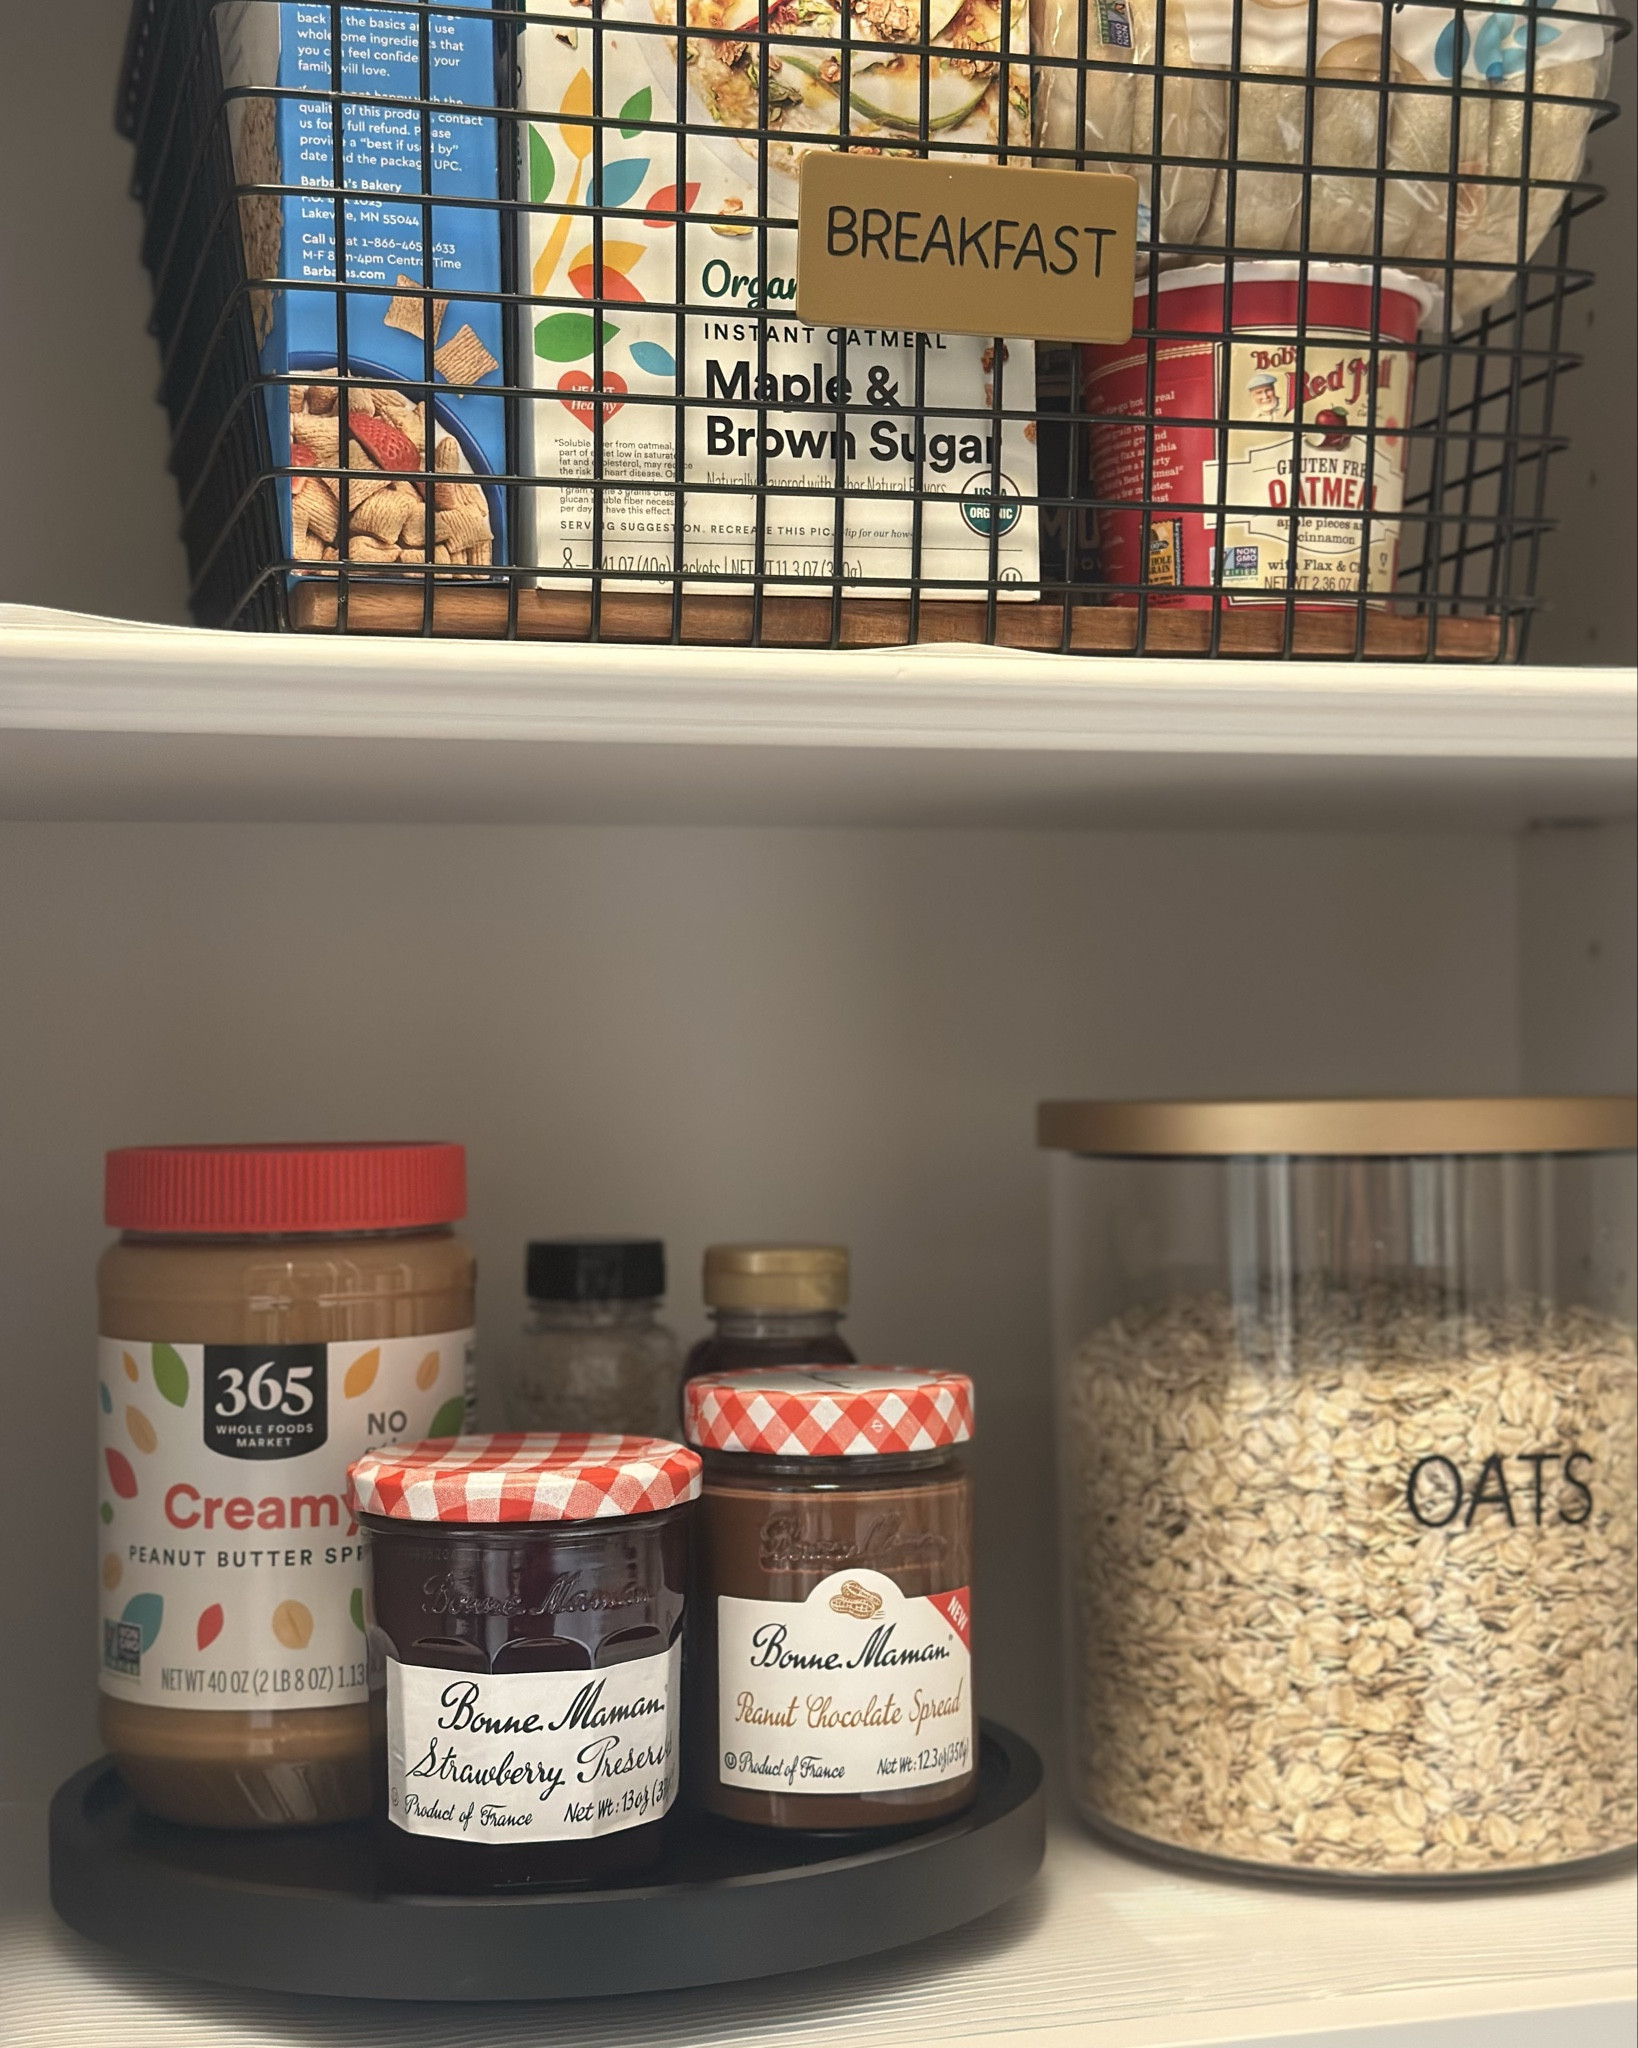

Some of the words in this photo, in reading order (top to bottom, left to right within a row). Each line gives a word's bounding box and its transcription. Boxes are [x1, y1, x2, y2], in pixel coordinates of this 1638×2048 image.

[297, 12, 326, 24] back
[346, 16, 366, 27] the
[369, 17, 406, 30] basics
[435, 26, 455, 34] use
[297, 30, 367, 43] wholeome
[440, 40, 464, 52] that
[297, 46, 319, 57] you
[349, 48, 370, 60] feel
[434, 55, 460, 67] your
[362, 65, 390, 77] love.
[299, 102, 332, 115] qualit
[344, 103, 356, 115] of
[359, 105, 381, 118] this
[438, 113, 484, 126] contact
[300, 120, 313, 129] us
[347, 121, 366, 133] full
[369, 122, 411, 136] refund.
[414, 126, 452, 139] Pase
[350, 140, 357, 148] a
[395, 139, 404, 151] if
[300, 150, 328, 161] date
[357, 153, 377, 165] the
[381, 155, 422, 171] packag
[435, 159, 463, 172] UPC.
[361, 179, 402, 194] Bakery
[360, 212, 380, 223] MN
[383, 215, 420, 227] 55044
[302, 233, 326, 245] Call
[346, 236, 357, 247] at
[827, 205, 1117, 278] BREAKFAST
[302, 249, 325, 261] M-F
[433, 257, 463, 270] Time
[704, 321, 815, 345] INSTANT
[826, 327, 948, 350] OATMEAL
[705, 358, 853, 413] Maple
[866, 364, 901, 407] &
[1284, 357, 1345, 417] Red
[615, 440, 636, 450] from
[706, 413, 857, 460] Brown
[1155, 441, 1177, 453] chia
[559, 448, 577, 458] part
[579, 448, 589, 456] of
[616, 450, 633, 458] low
[633, 451, 642, 459] in
[559, 458, 571, 466] fat
[573, 459, 589, 467] and
[643, 462, 662, 471] may
[559, 467, 574, 476] the
[575, 467, 591, 476] risk
[604, 469, 627, 477] heart
[629, 470, 663, 478] disease.
[560, 495, 589, 506] glucan
[623, 496, 644, 506] fiber
[560, 505, 574, 514] per
[576, 505, 593, 516] day
[605, 507, 626, 515] have
[628, 507, 644, 515] this
[645, 507, 673, 516] effect.
[710, 524, 773, 535] RECREAE
[777, 526, 806, 536] THIS
[810, 527, 835, 537] PIC.
[858, 529, 872, 540] for
[873, 530, 889, 538] our
[1316, 518, 1350, 531] pieces
[1297, 531, 1355, 545] cinnamon
[1304, 559, 1333, 572] Flax
[1336, 561, 1347, 572] &
[214, 1361, 315, 1418] 365
[215, 1424, 263, 1435] WHOLE
[267, 1422, 315, 1434] FOODS
[367, 1410, 408, 1436] NO
[236, 1437, 292, 1448] MARKET
[1406, 1452, 1594, 1528] OATS
[164, 1483, 362, 1537] Creamy
[128, 1545, 206, 1568] PEANUT
[217, 1548, 313, 1568] BUTTER
[946, 1595, 969, 1631] NEW
[749, 1622, 843, 1671] Bonne
[846, 1622, 951, 1671] Maman
[160, 1667, 184, 1692] NET
[185, 1669, 205, 1693] WT
[207, 1670, 227, 1694] 40
[230, 1670, 249, 1694] OZ
[252, 1668, 269, 1696] (2
[272, 1669, 291, 1693] LB
[294, 1668, 304, 1692] 8
[308, 1665, 334, 1693] OZ)
[437, 1680, 544, 1735] Bonne
[547, 1677, 665, 1732] Maman
[734, 1690, 798, 1729] Peanut
[805, 1691, 902, 1729] Chocolate
[908, 1676, 965, 1737] Spread
[405, 1737, 566, 1801] Strawberry
[739, 1750, 784, 1777] Product
[783, 1755, 799, 1786] of
[800, 1755, 846, 1779] France
[876, 1757, 898, 1776] Net
[404, 1793, 455, 1821] Product
[458, 1801, 475, 1832] of
[480, 1803, 533, 1827] France
[563, 1801, 594, 1823] Net
